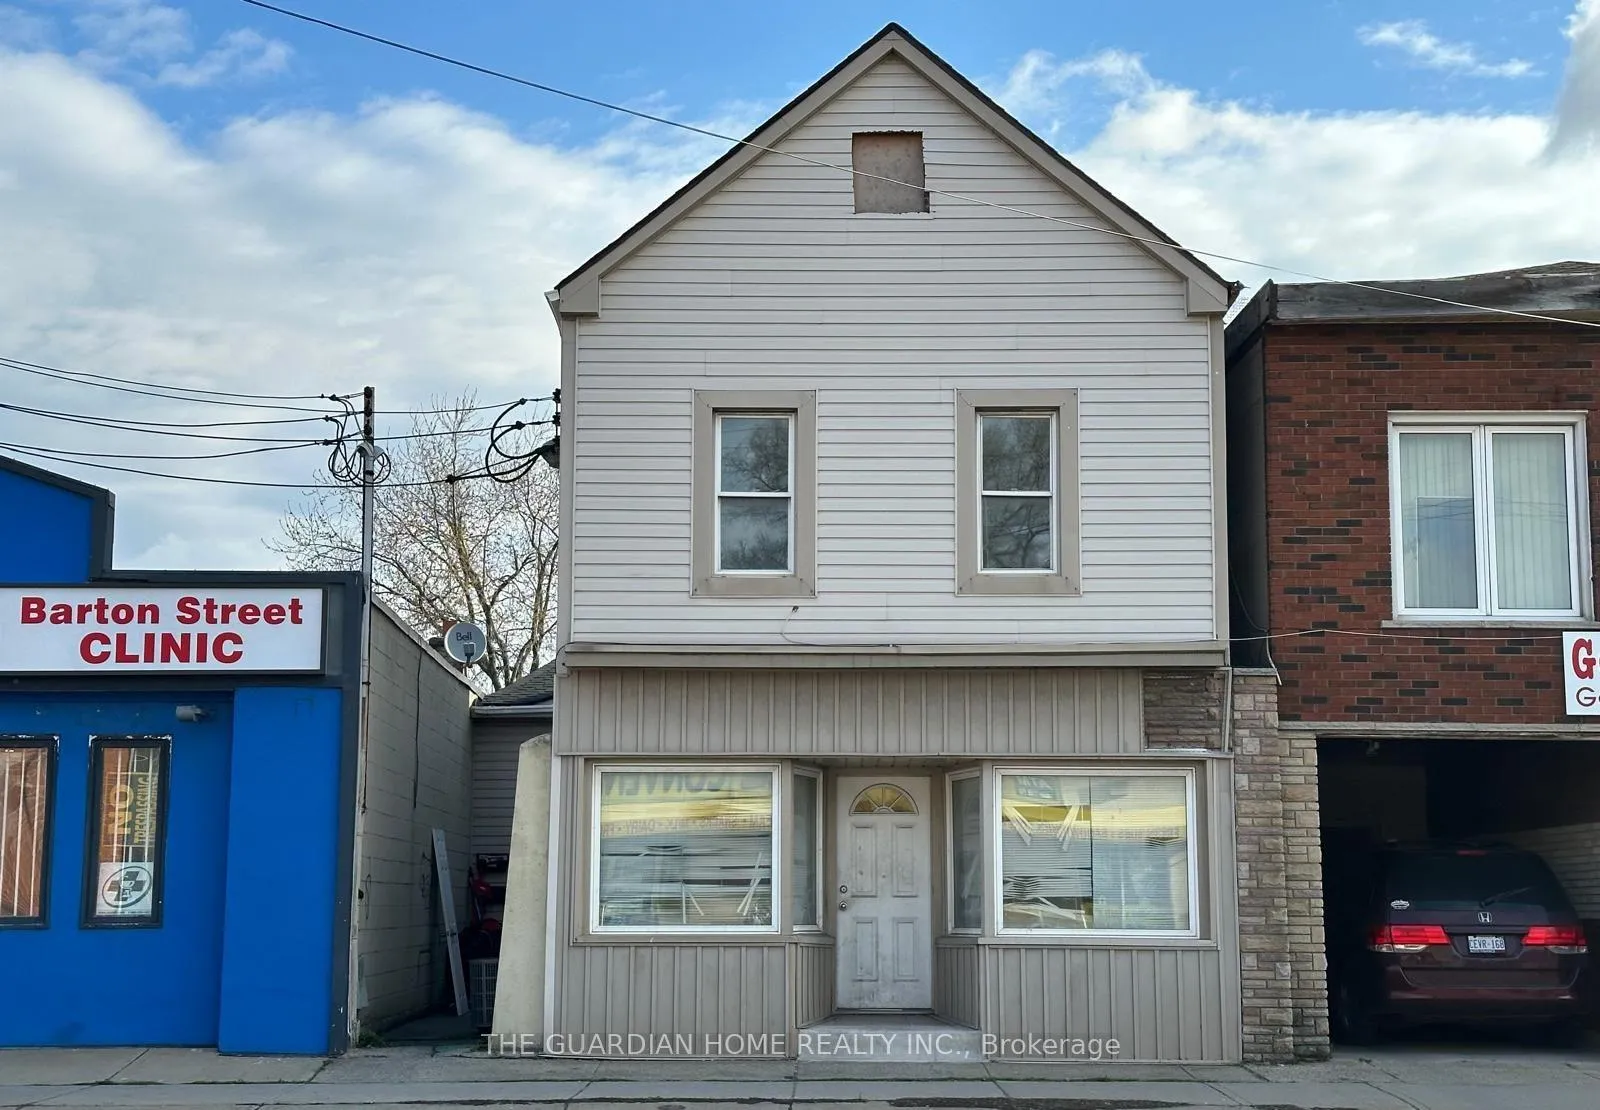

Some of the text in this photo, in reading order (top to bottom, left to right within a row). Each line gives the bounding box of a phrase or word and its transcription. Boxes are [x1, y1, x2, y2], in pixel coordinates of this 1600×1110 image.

[20, 596, 304, 625] Barton Street
[79, 632, 244, 665] CLINIC
[456, 631, 473, 641] Bell
[1571, 637, 1600, 680] G
[1576, 686, 1600, 707] G
[106, 784, 135, 836] NO
